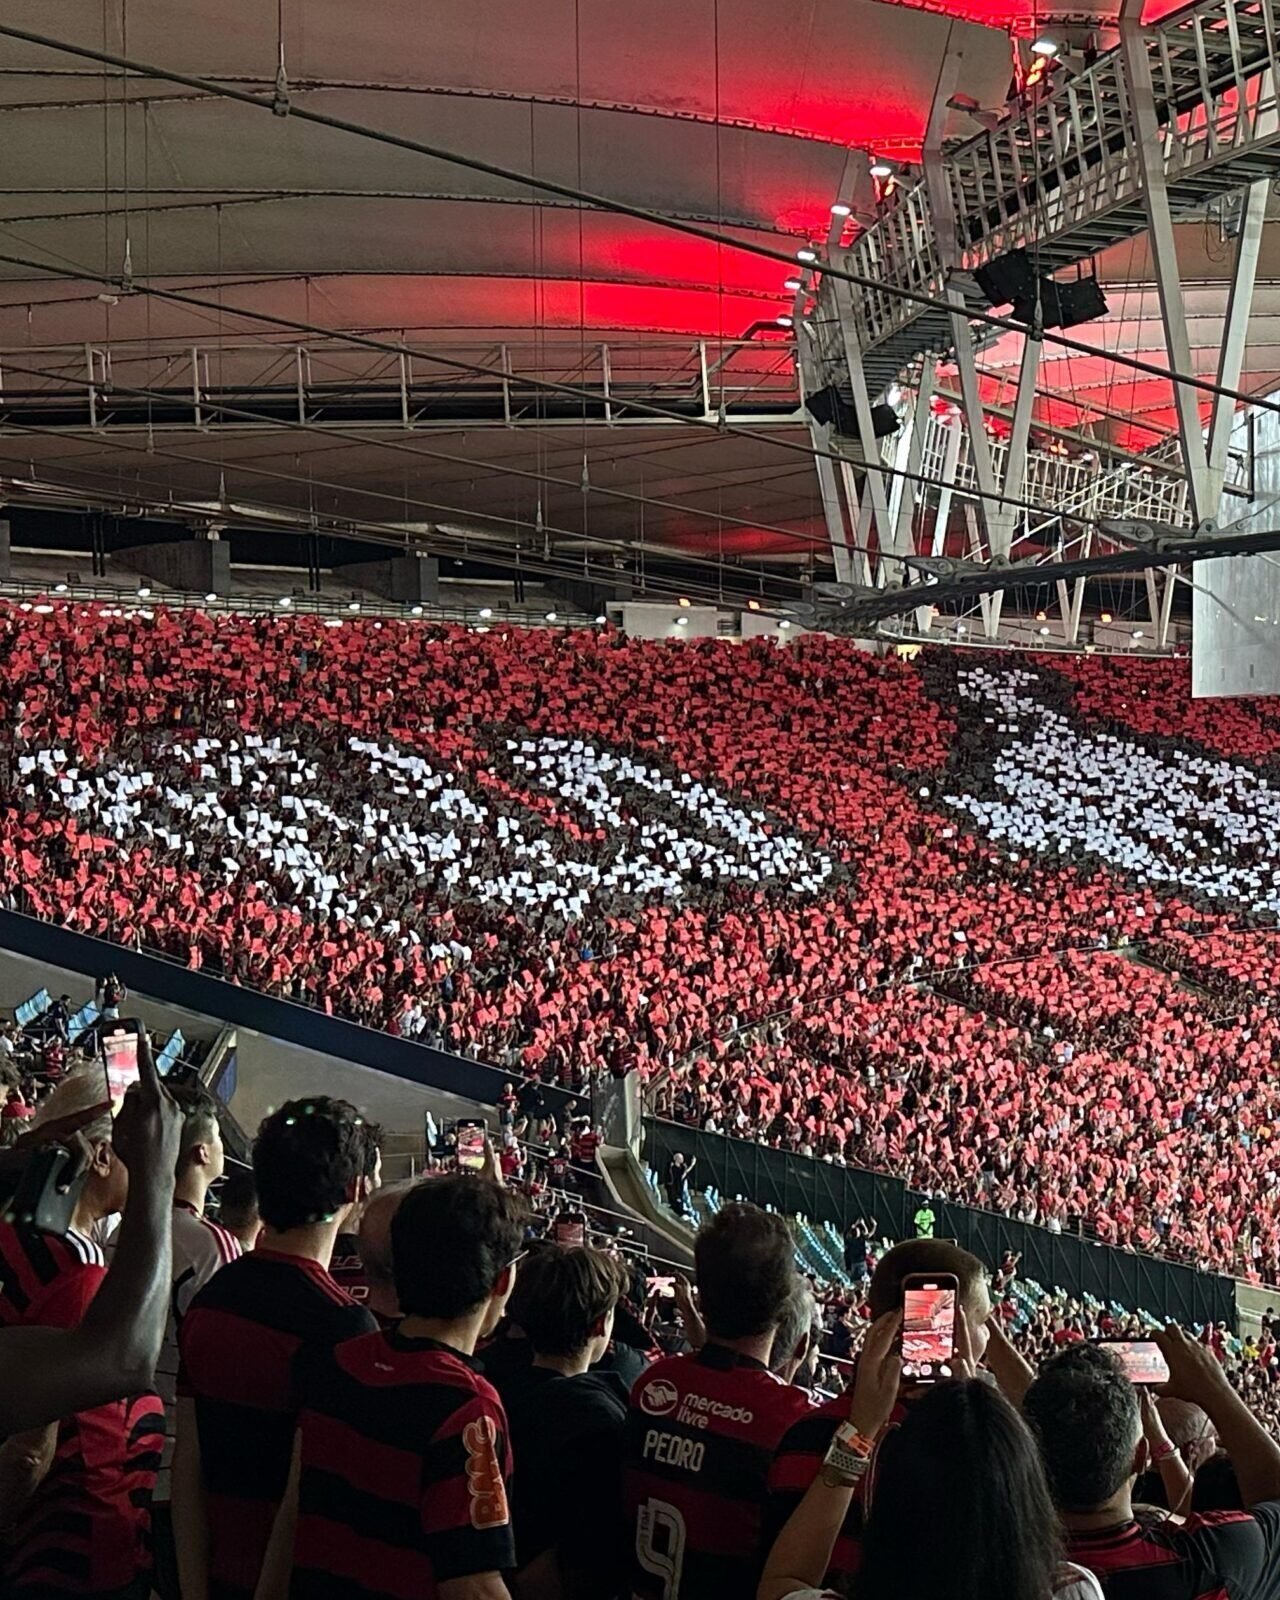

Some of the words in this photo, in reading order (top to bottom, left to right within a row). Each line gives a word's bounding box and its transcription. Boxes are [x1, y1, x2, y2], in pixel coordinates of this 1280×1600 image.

[676, 1405, 709, 1429] livre
[683, 1392, 754, 1424] mercado
[642, 1429, 706, 1472] PEDRO
[635, 1496, 687, 1600] 9
